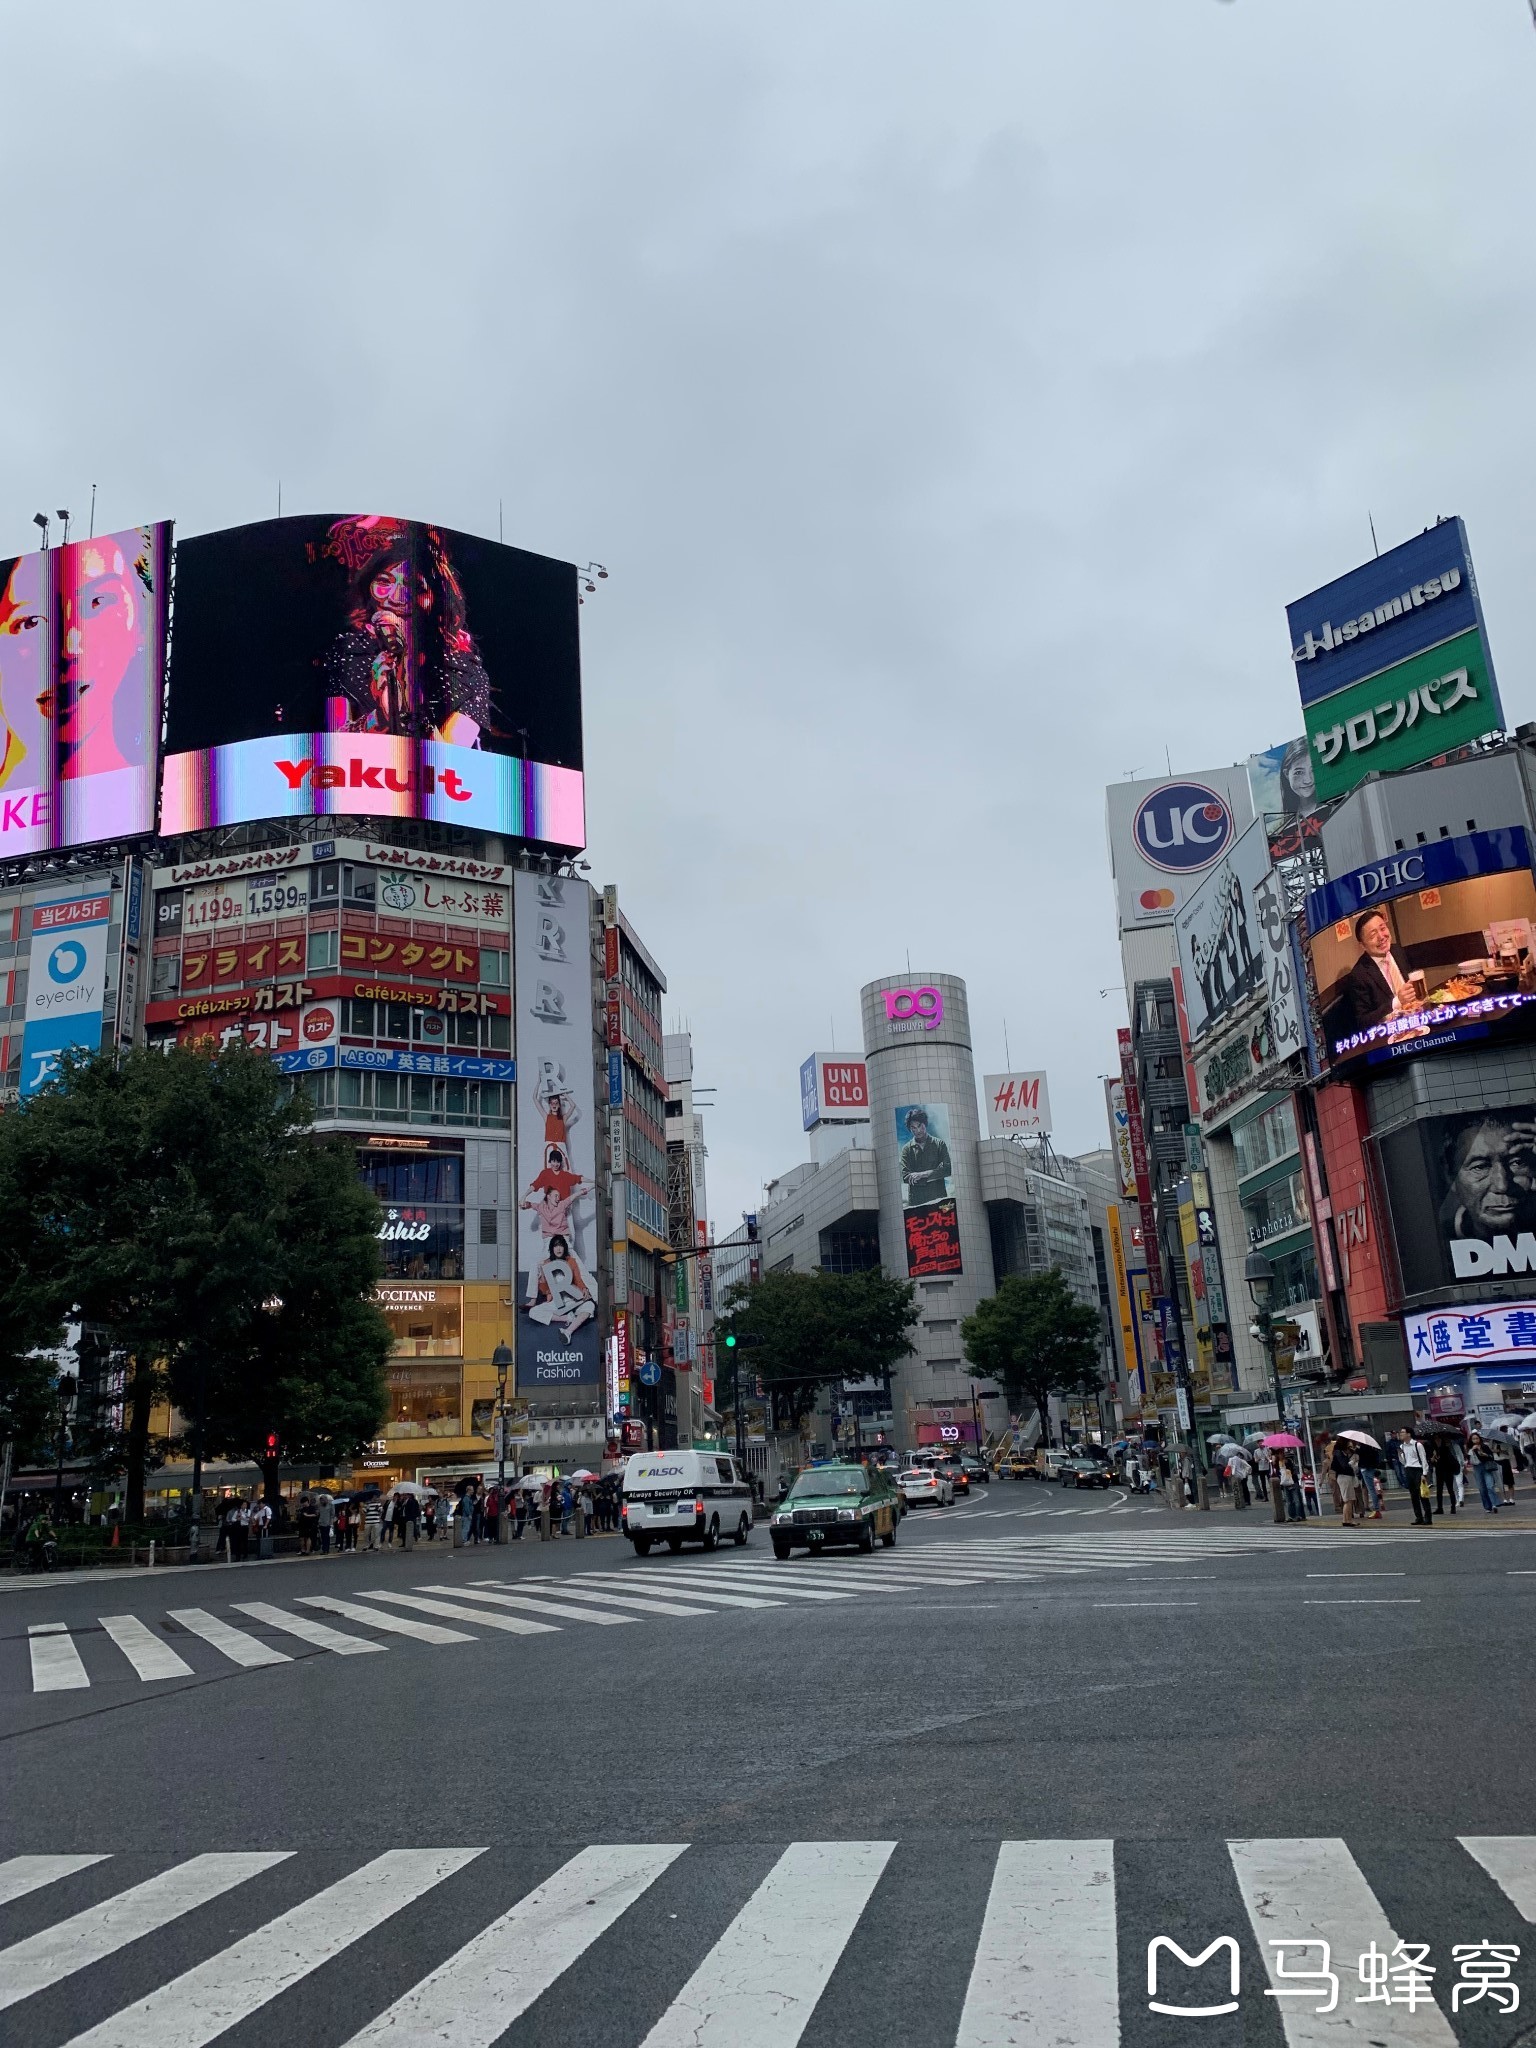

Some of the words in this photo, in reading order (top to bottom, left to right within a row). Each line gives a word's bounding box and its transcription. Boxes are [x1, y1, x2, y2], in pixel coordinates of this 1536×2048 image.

[1292, 566, 1460, 661] Hisamitsu
[1313, 666, 1477, 765] サロンパス
[273, 756, 473, 801] Yakult
[172, 847, 300, 883] しゃぶしゃぶバイキング
[366, 844, 505, 880] しゃぶしゃぶバイキング
[1357, 855, 1425, 898] DHC
[40, 900, 103, 927] 当ビル5F
[158, 904, 181, 922] 9F
[187, 896, 242, 928] 1,199円
[249, 886, 307, 917] 1,599円
[423, 883, 504, 918] しゃぶ葉
[185, 940, 302, 981] プライス
[342, 935, 478, 974] コンタクト
[36, 984, 95, 1008] eyecity
[178, 997, 250, 1018] Caféレストラン
[254, 982, 314, 1012] ガスト
[354, 983, 433, 1005] Caféレストラン
[437, 989, 497, 1016] ガスト
[881, 987, 944, 1030] 109
[307, 1022, 332, 1034] ガスト
[610, 1013, 619, 1039] ガスト
[887, 1021, 923, 1034] SHIBUYA
[309, 1052, 325, 1064] 6F
[1391, 1042, 1413, 1056] DHC
[1414, 1033, 1457, 1050] Channel
[345, 1050, 388, 1066] AEON
[397, 1052, 512, 1078] 英会話イーオン
[828, 1068, 859, 1084] UNI
[829, 1086, 863, 1104] QLO
[994, 1078, 1040, 1112] H&M
[613, 1120, 622, 1169] 渋谷駅前ビル
[1249, 1214, 1293, 1242] Euphoria
[536, 1350, 584, 1366] Rakuten
[536, 1366, 581, 1379] Fashion
[936, 1410, 951, 1420] 109
[940, 1427, 959, 1440] 109
[648, 1466, 684, 1477] ALSOK
[628, 1491, 652, 1499] Always
[654, 1490, 682, 1498] Security
[683, 1488, 694, 1496] OK
